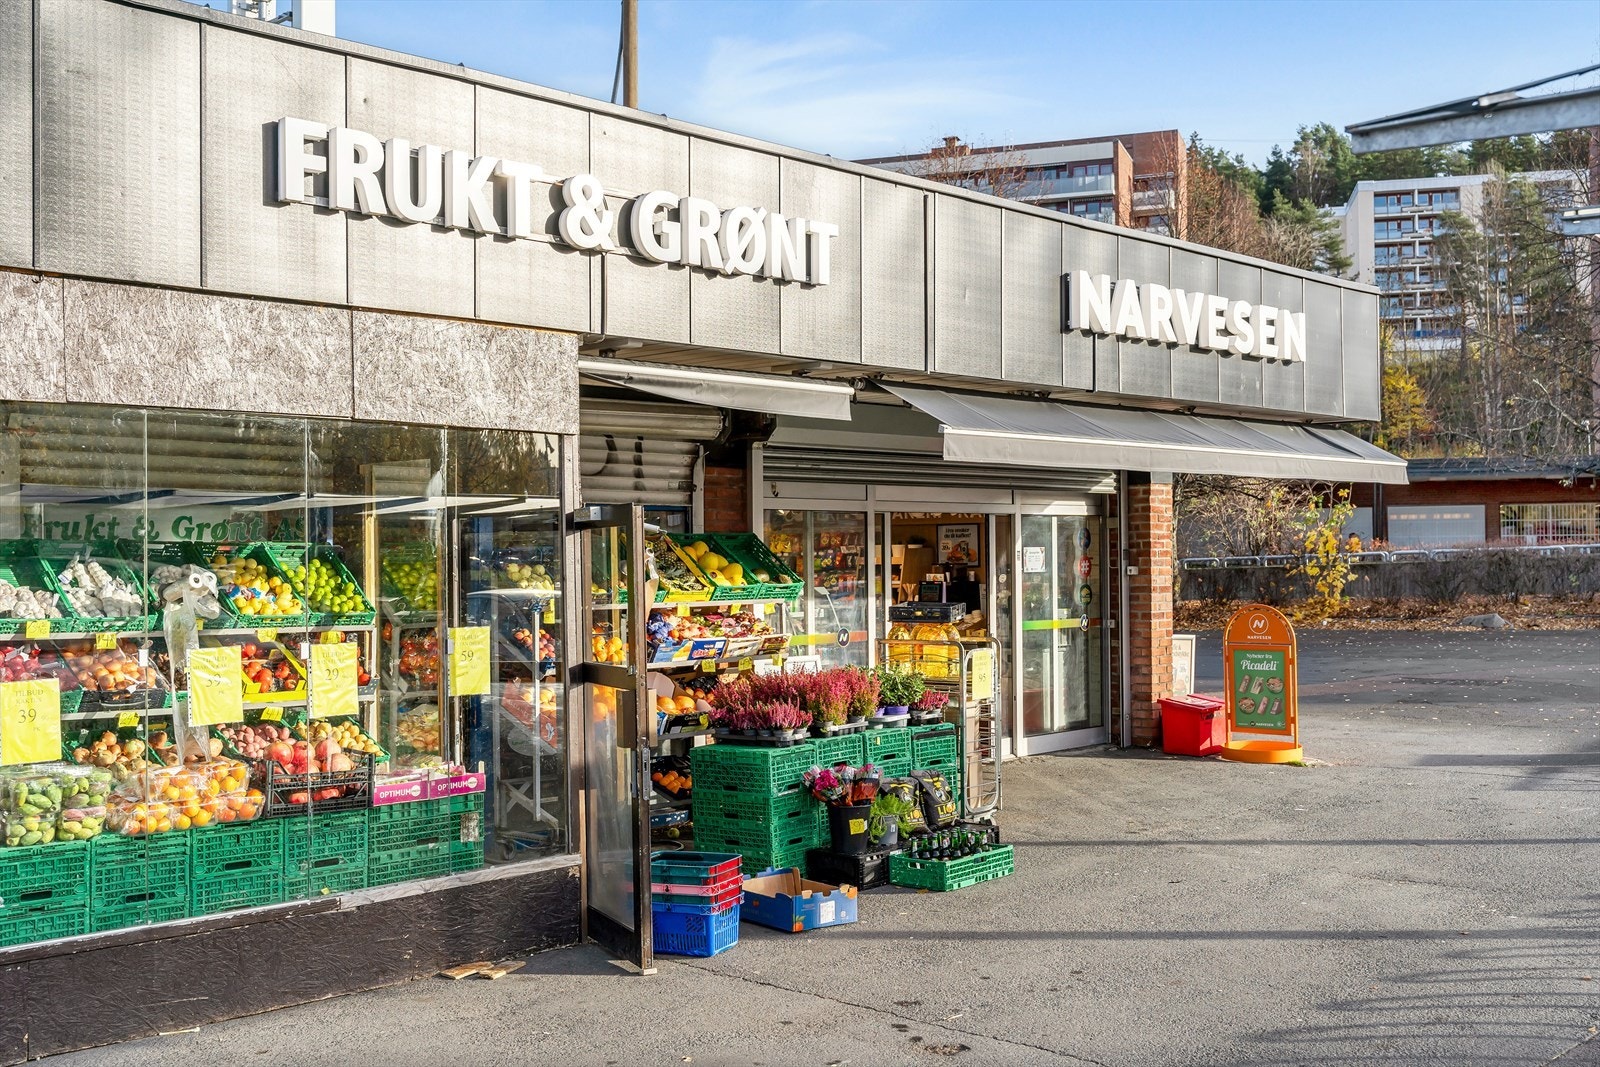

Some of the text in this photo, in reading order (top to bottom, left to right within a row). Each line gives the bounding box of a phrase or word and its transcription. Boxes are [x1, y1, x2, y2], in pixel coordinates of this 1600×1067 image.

[279, 117, 839, 286] FRUKT & GRØNT
[1071, 270, 1306, 362] NARVESEN
[22, 513, 121, 541] Frukt
[172, 515, 263, 542] Grønt
[461, 650, 474, 662] 59
[1241, 660, 1277, 670] Picadeli
[325, 668, 339, 680] 29
[15, 689, 43, 697] TILBUD
[18, 708, 36, 723] 39
[438, 780, 468, 791] OPTIMUM
[380, 789, 411, 799] OPTIMUM
